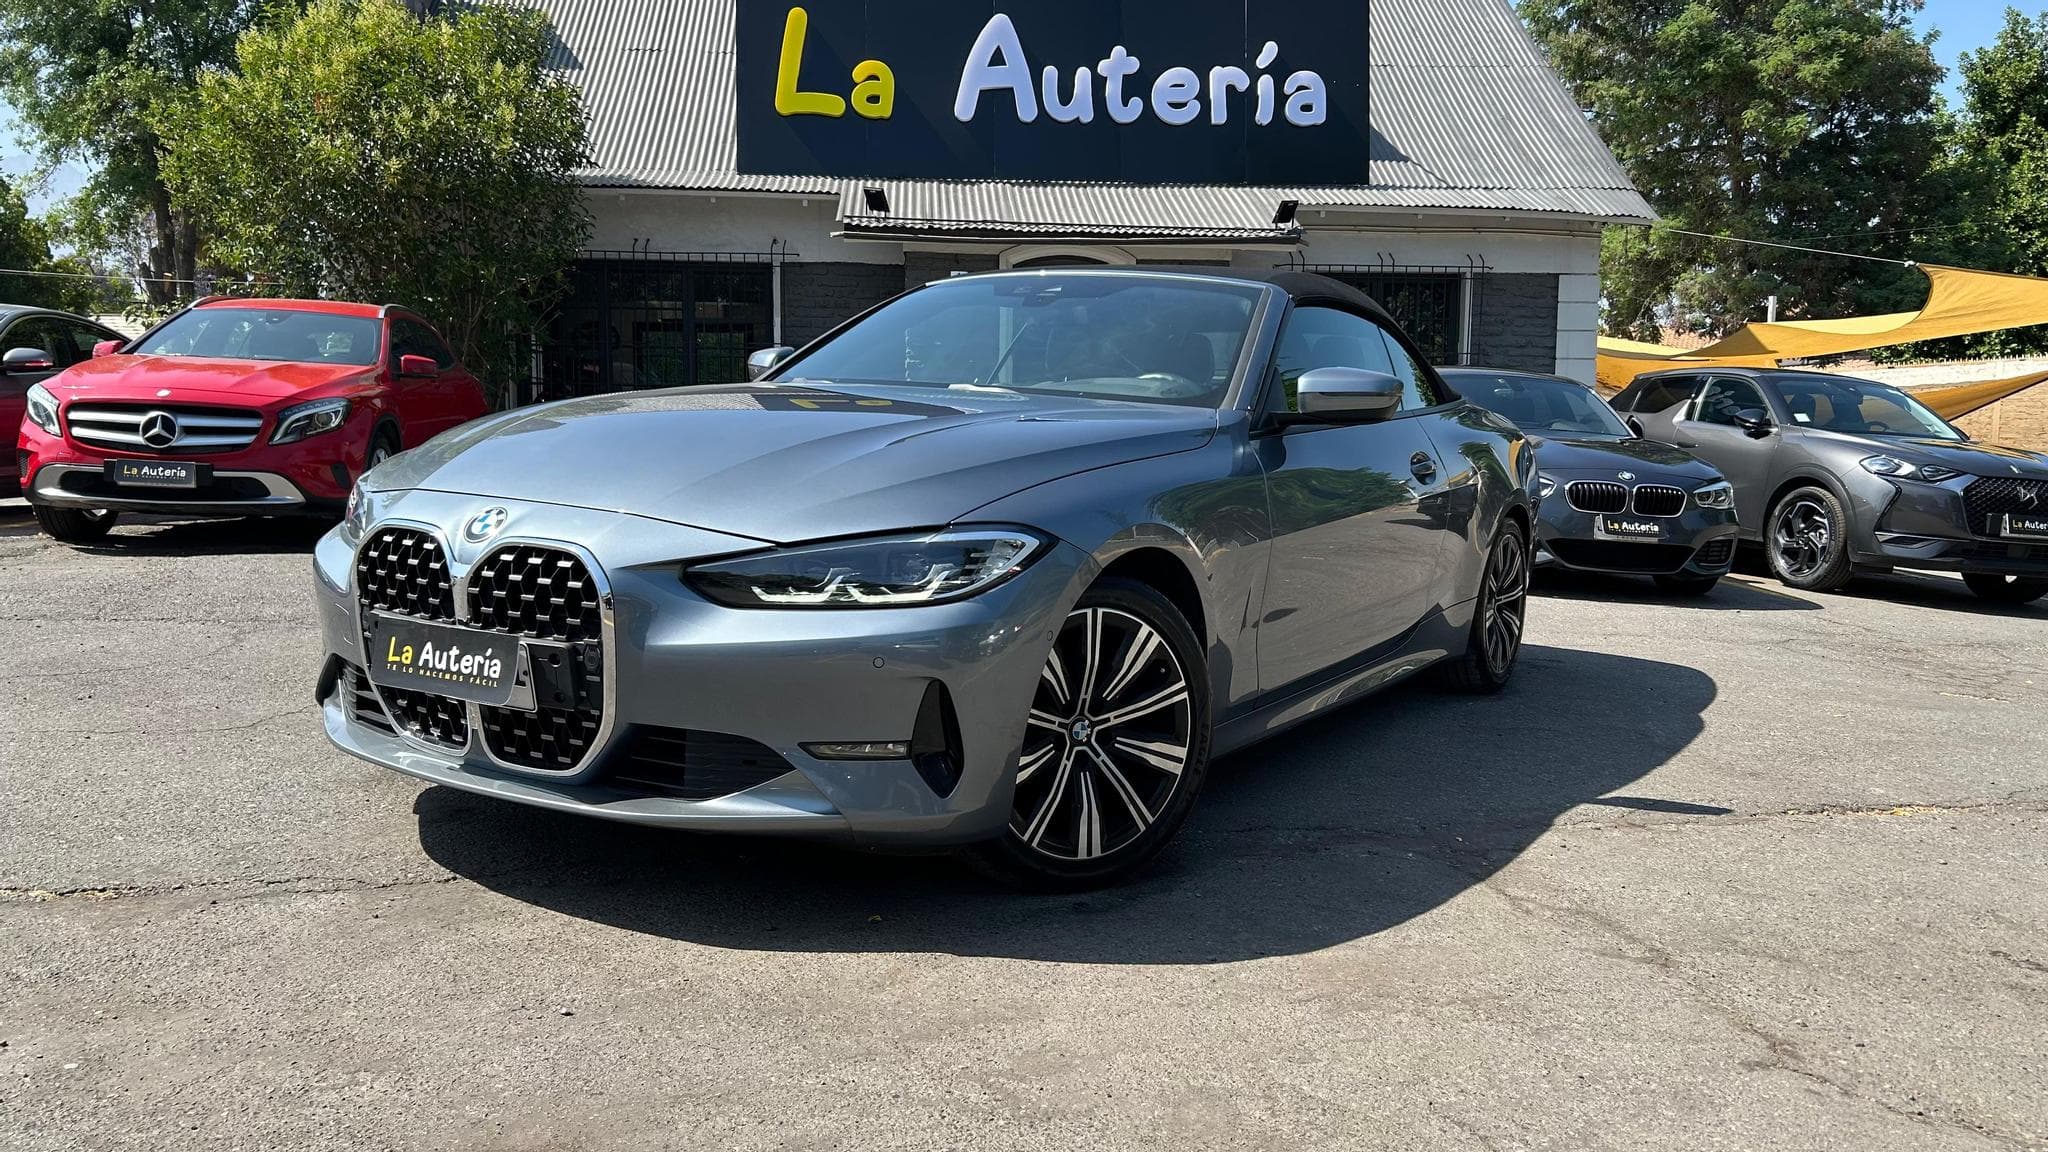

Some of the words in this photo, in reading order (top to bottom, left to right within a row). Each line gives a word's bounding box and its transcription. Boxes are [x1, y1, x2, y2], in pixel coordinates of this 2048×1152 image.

[774, 7, 896, 120] La
[954, 13, 1327, 126] Autería
[124, 465, 138, 475] La
[141, 466, 186, 477] Autería
[1607, 520, 1619, 529] La
[2012, 519, 2023, 528] La
[387, 636, 413, 664] La
[418, 641, 501, 678] Autería
[385, 663, 397, 671] TE
[402, 665, 413, 674] LO
[419, 669, 463, 681] HACEMOS
